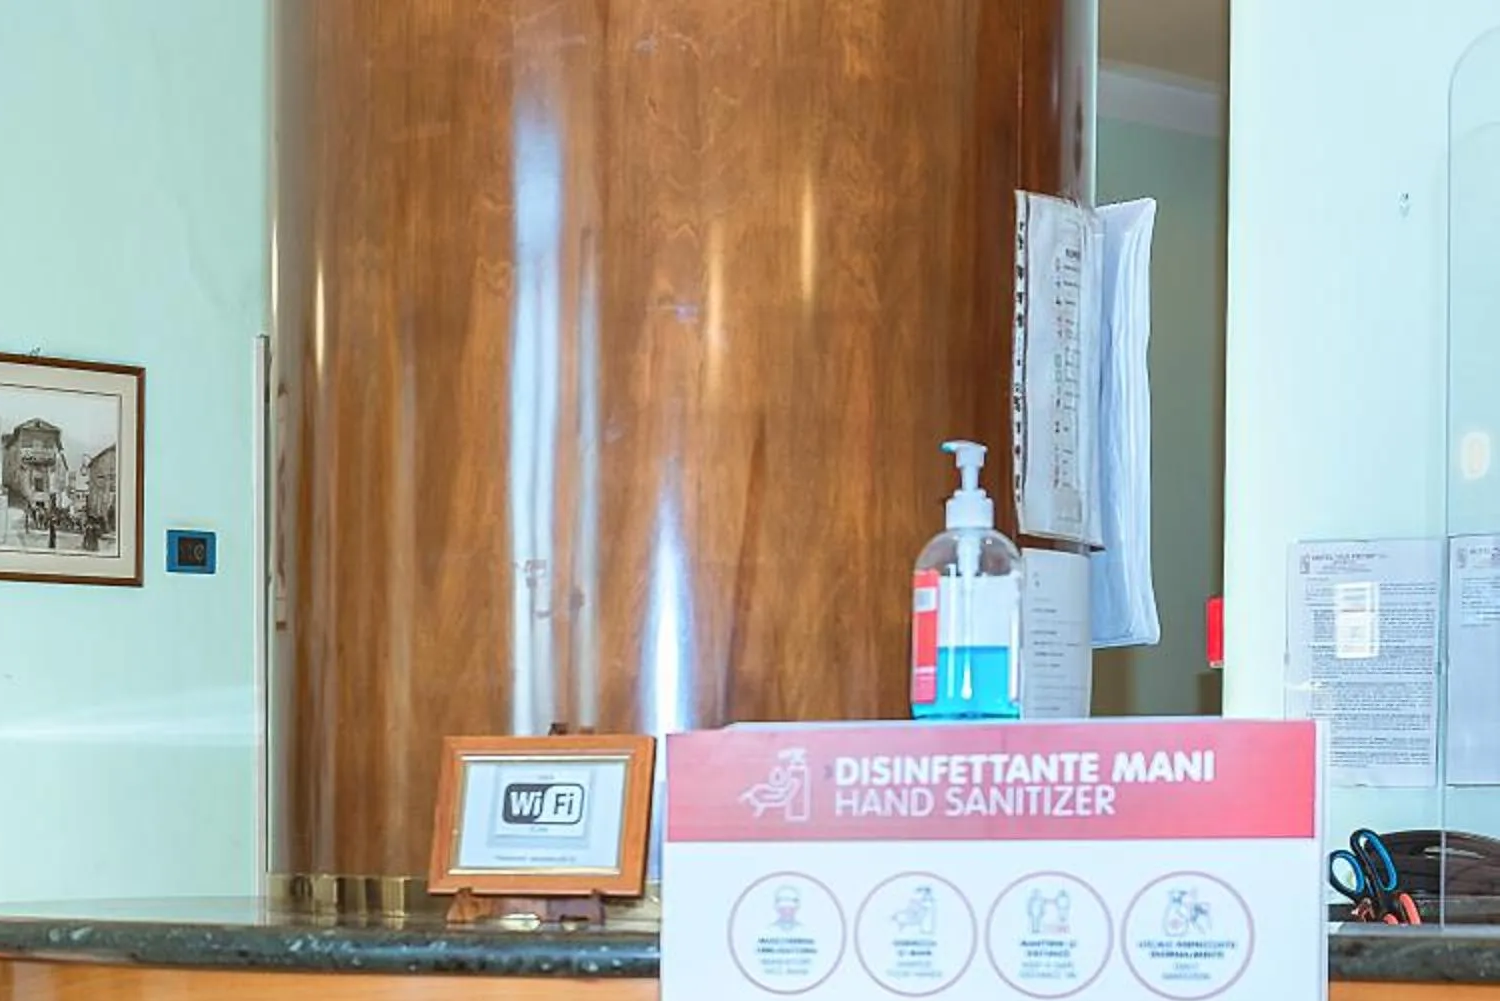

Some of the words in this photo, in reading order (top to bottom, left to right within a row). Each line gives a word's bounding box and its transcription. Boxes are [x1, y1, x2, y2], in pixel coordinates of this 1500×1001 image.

[834, 753, 1098, 786] DISINFETTANTE
[1112, 750, 1214, 782] MANI
[835, 788, 933, 819] HAND
[944, 784, 1116, 817] SANITIZER
